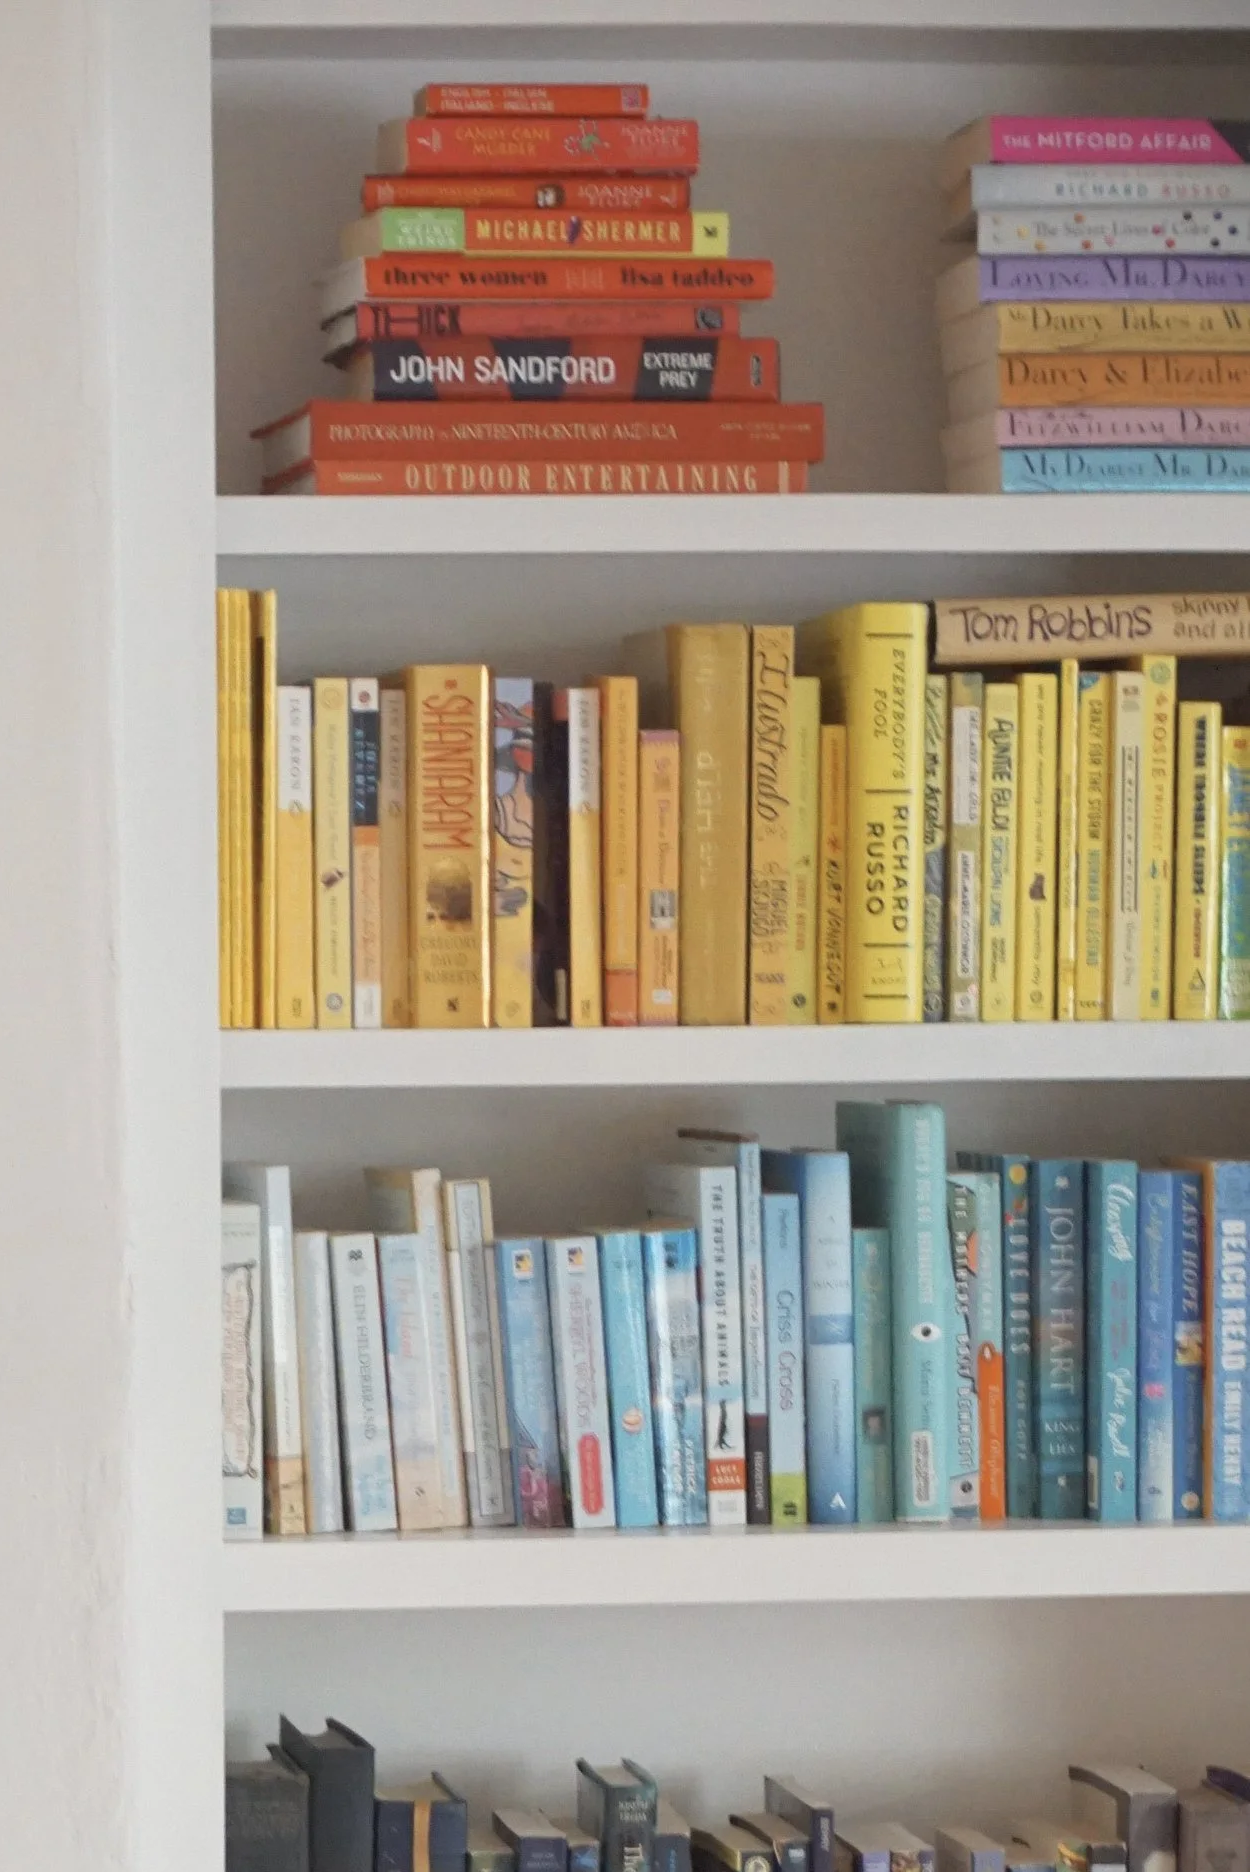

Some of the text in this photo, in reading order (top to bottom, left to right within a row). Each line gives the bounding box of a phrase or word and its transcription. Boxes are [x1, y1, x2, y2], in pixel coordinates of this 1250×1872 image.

[1002, 131, 1212, 152] THE MITFORD AFFAIR
[1054, 182, 1149, 198] RICHARD
[476, 219, 569, 243] MICHAEL
[581, 219, 682, 243] SHERMER
[383, 266, 548, 287] three women
[619, 266, 755, 287] lisa taddeo
[1199, 315, 1214, 333] a
[389, 354, 616, 384] JOHN SANDFORD
[642, 352, 713, 371] EXTREME
[659, 371, 699, 388] PREY
[404, 463, 531, 492] OUTDOOR
[545, 463, 759, 493] ENTERTAINING
[949, 602, 1154, 643] Tom Robbins
[755, 652, 790, 823] Ilustrado
[872, 687, 887, 741] FOOL
[890, 646, 907, 781] EVERYBODY'S
[422, 694, 475, 850] SHANTARAM
[988, 717, 1015, 781] AUNTIE
[1151, 711, 1169, 780] ROSIE
[865, 821, 885, 916] RUSSO
[890, 803, 909, 933] RICHARD
[954, 1186, 969, 1219] THE
[711, 1184, 731, 1388] THE TRUTH ABOUT ANIMALS
[1046, 1204, 1076, 1396] JOHN HART
[1221, 1218, 1247, 1372] BEACH READ
[775, 1289, 797, 1412] Criss Cross
[957, 1386, 974, 1469] BENNETT
[1222, 1434, 1243, 1487] HENRY
